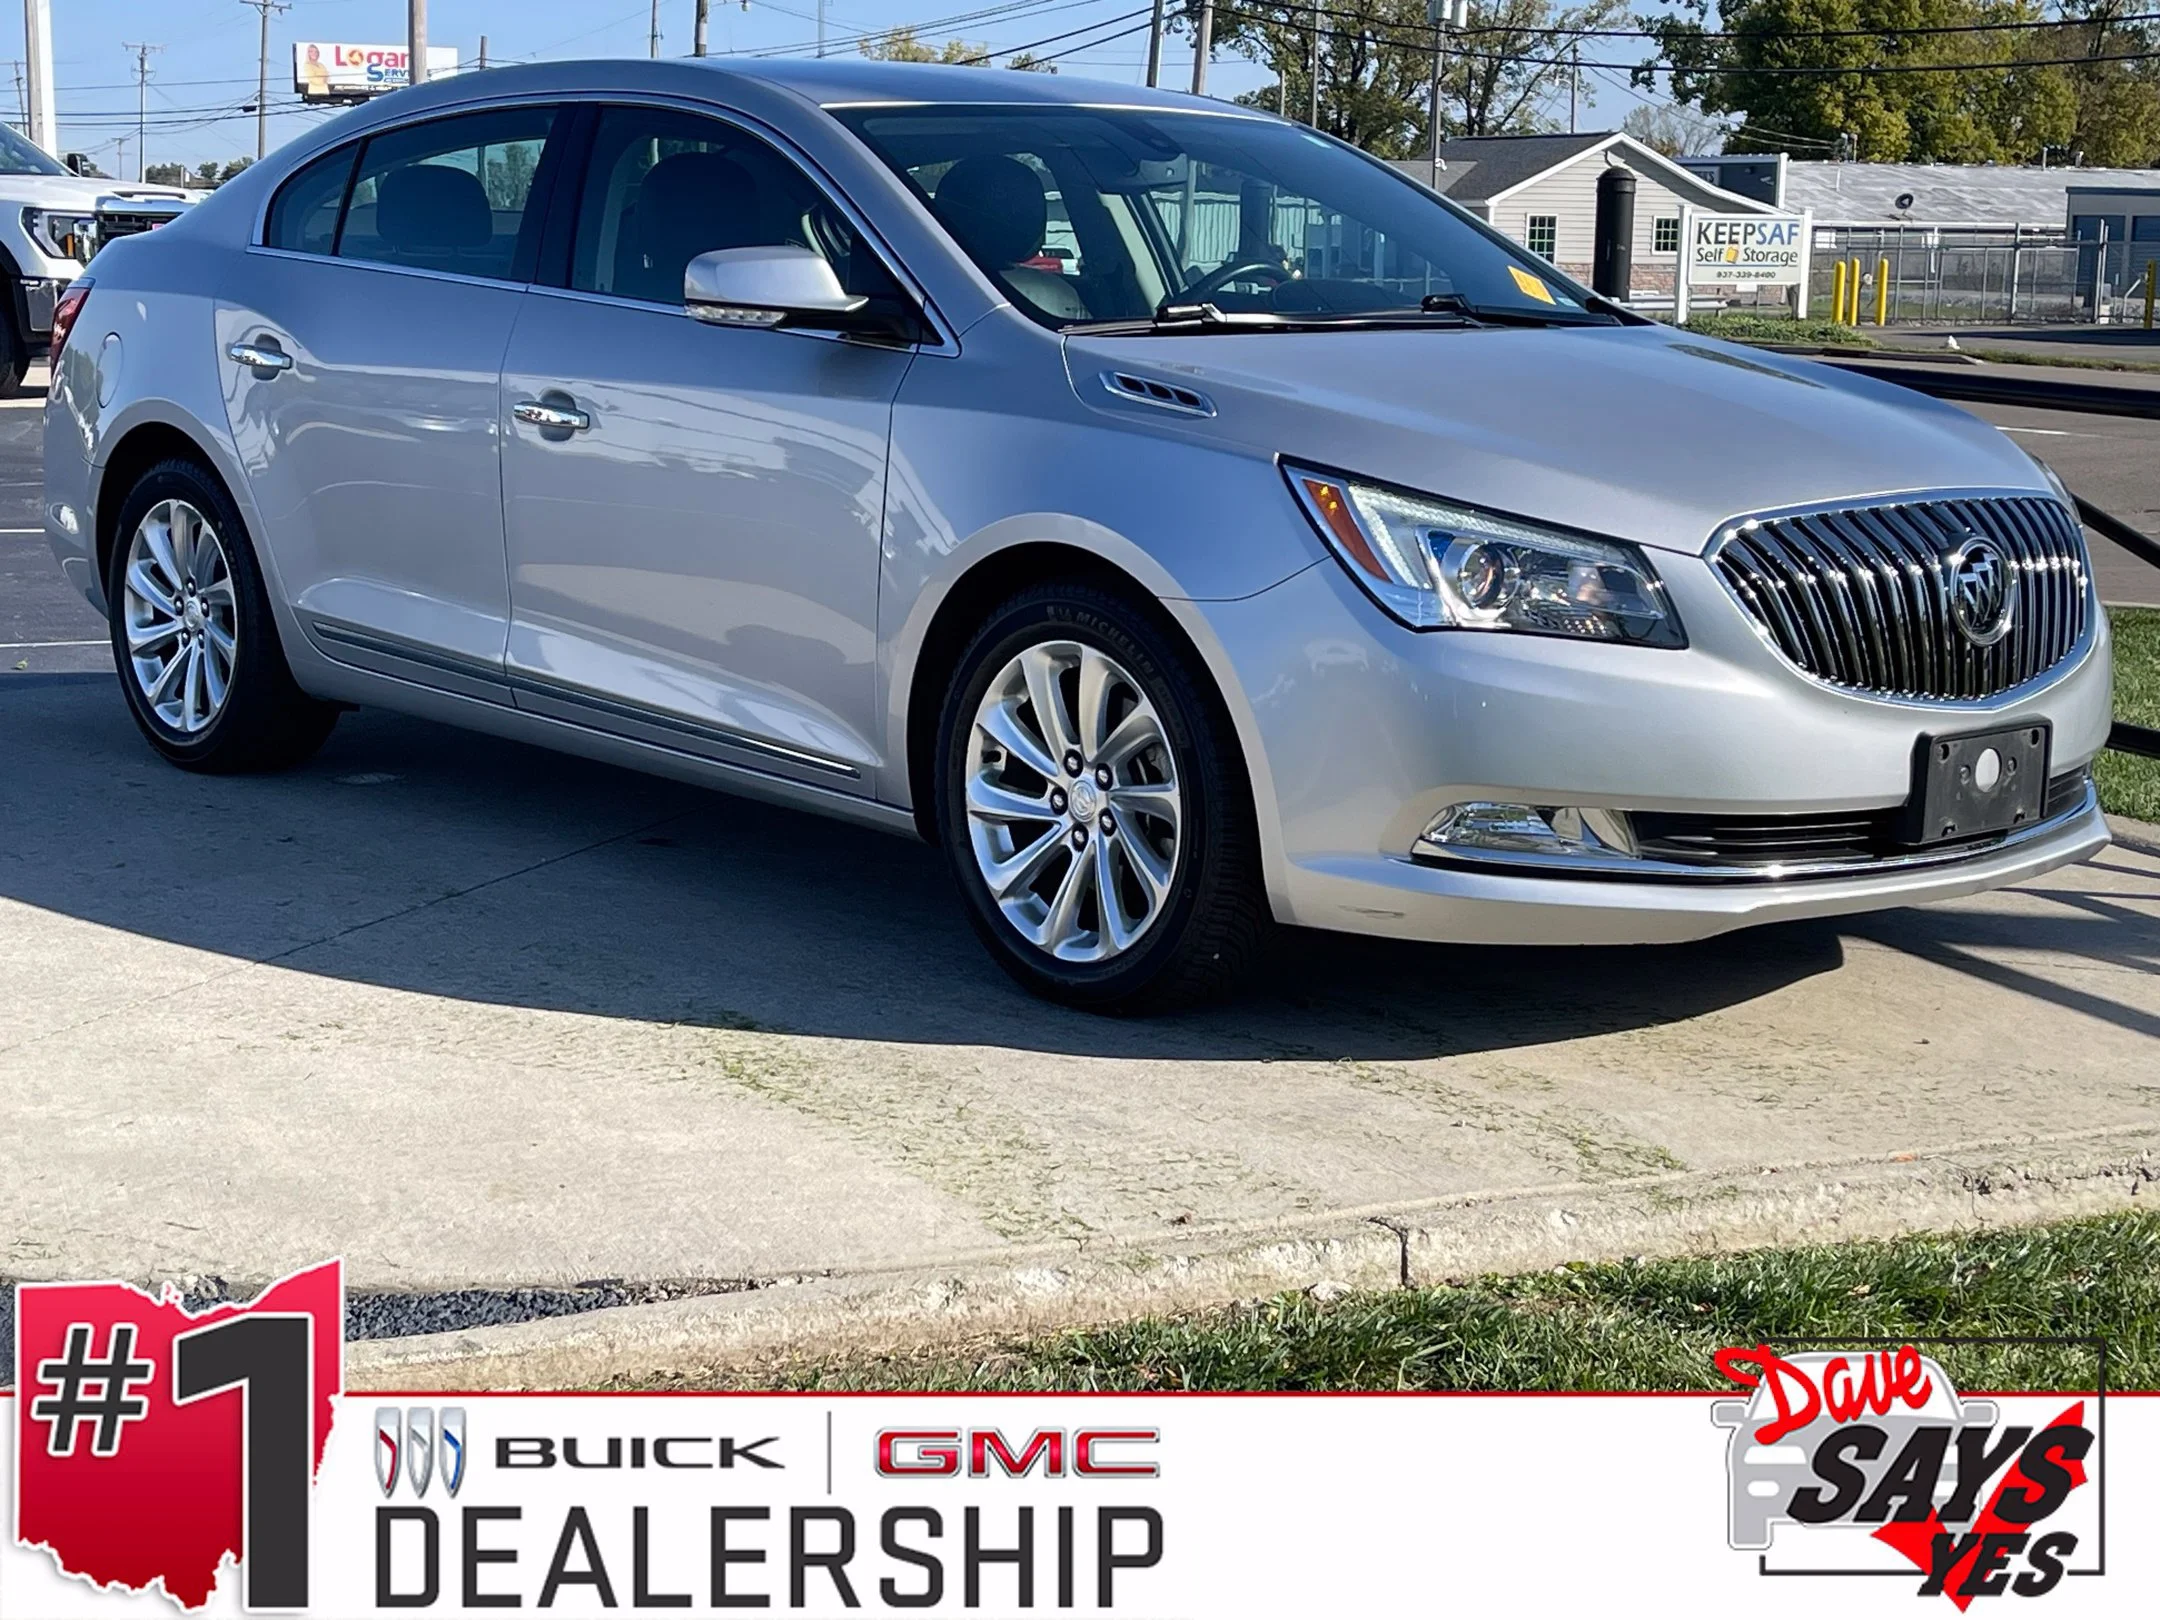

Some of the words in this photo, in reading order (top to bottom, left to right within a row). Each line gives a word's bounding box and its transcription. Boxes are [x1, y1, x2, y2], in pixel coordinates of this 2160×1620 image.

[1696, 222, 1800, 246] KEEPSAF
[1697, 247, 1724, 263] Self
[1743, 247, 1799, 267] Storage
[1076, 611, 1155, 675] MICHELIN
